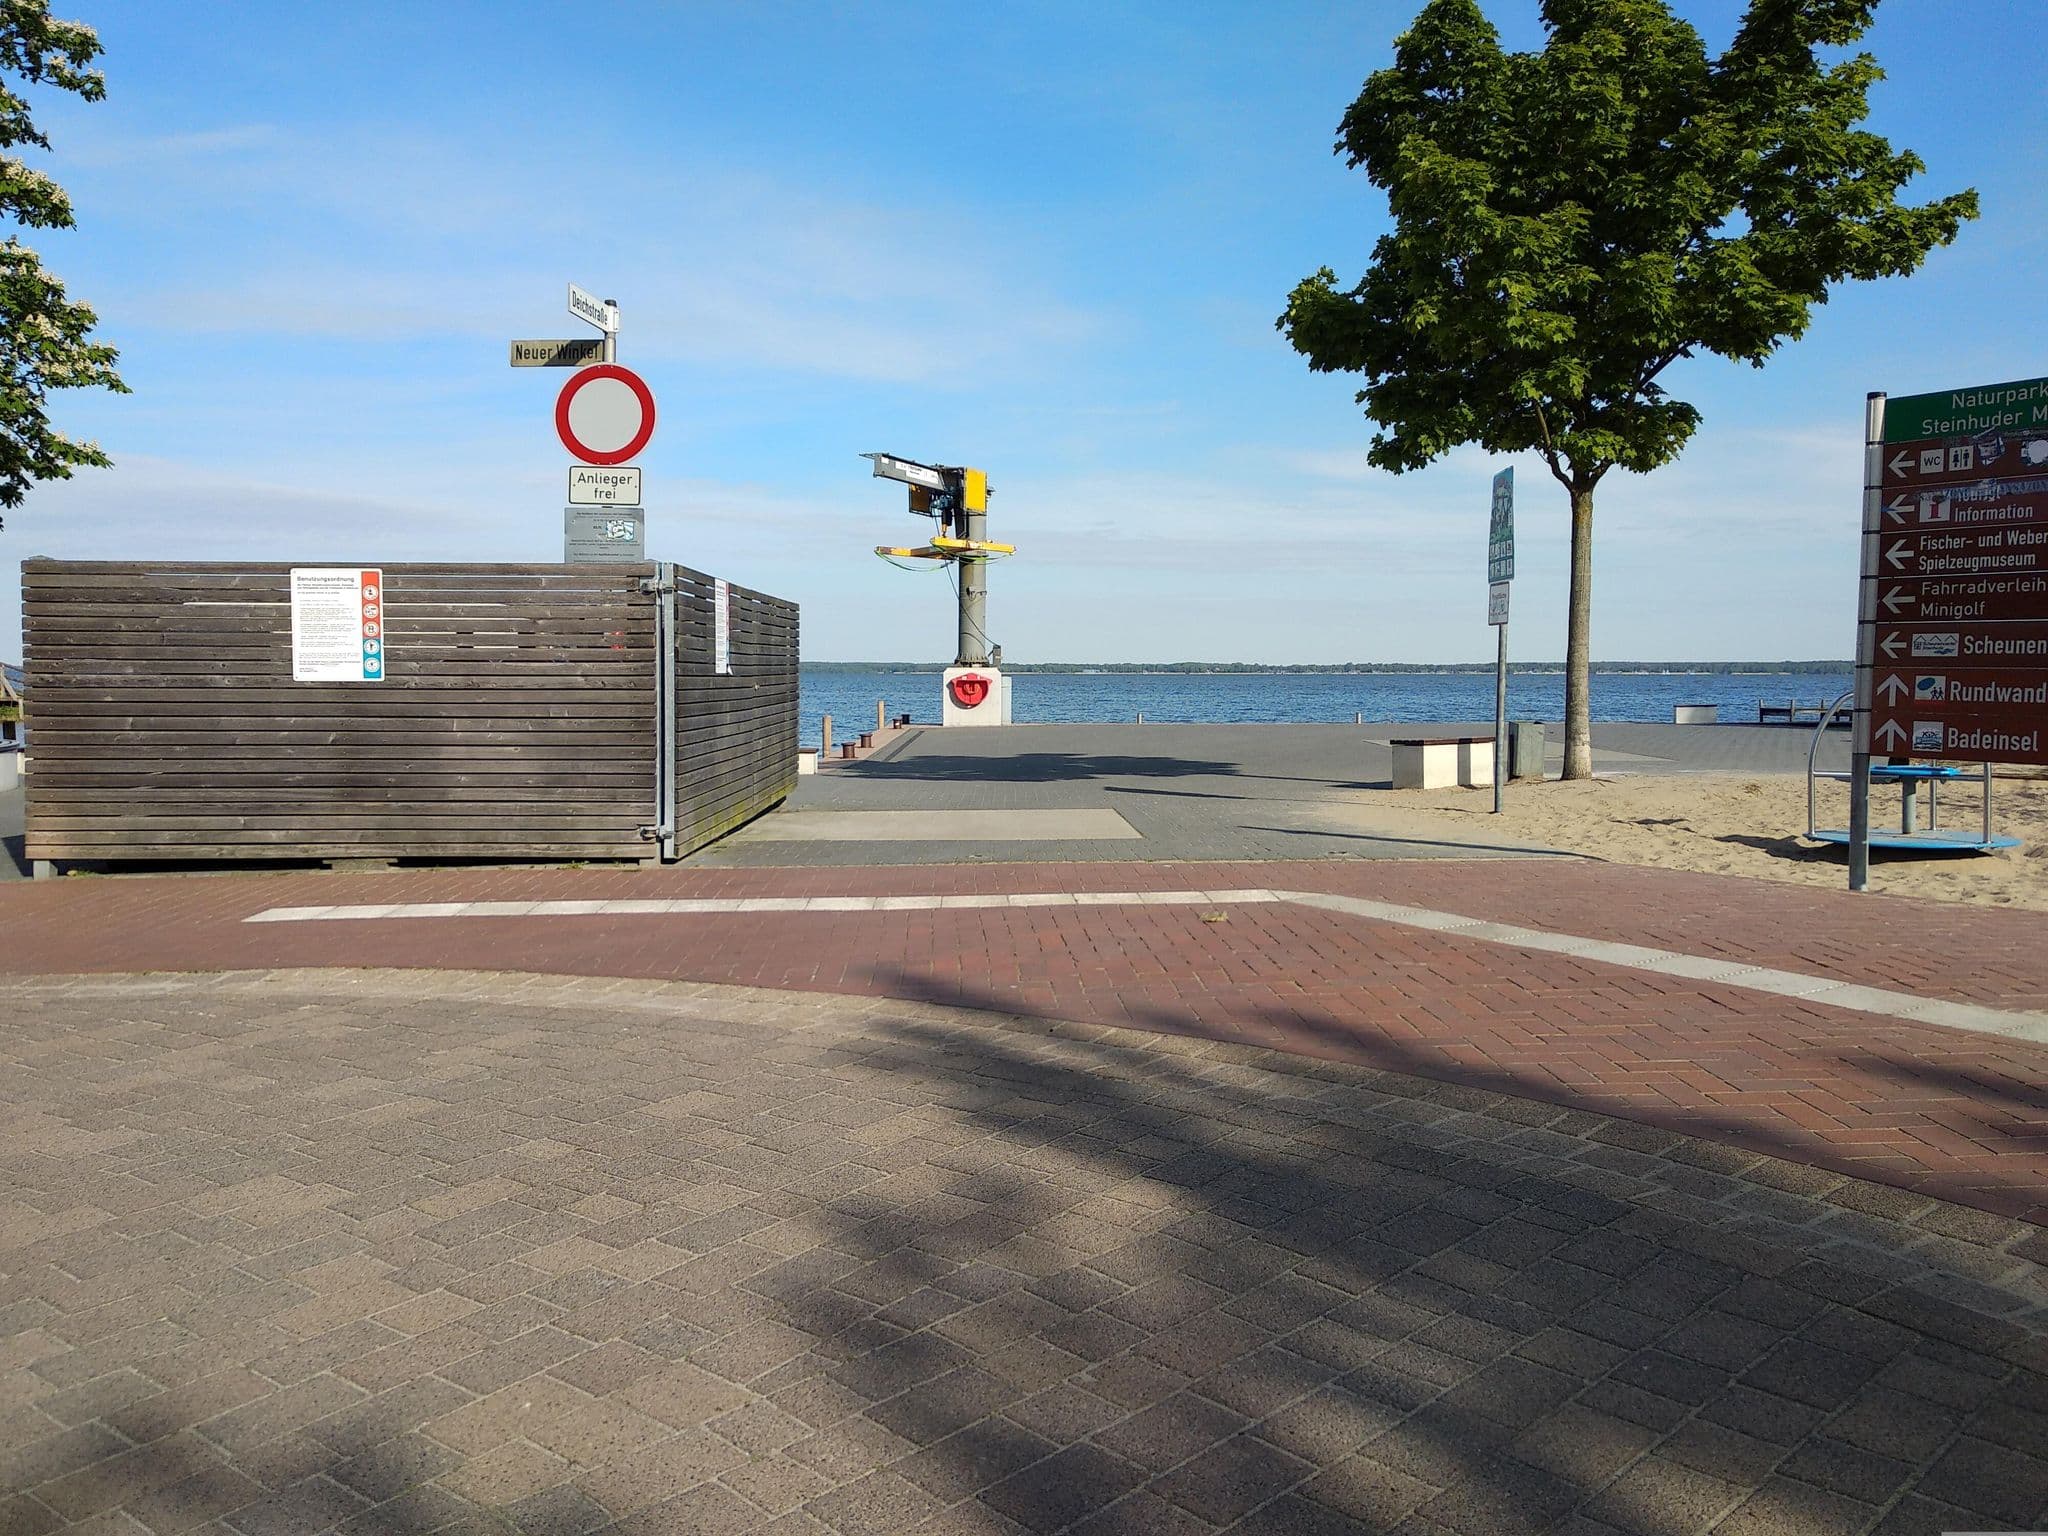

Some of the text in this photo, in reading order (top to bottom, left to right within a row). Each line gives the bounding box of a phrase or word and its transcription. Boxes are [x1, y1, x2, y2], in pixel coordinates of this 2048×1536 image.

[572, 290, 608, 325] Deichstraße
[515, 343, 598, 360] Neuer Winkel
[1952, 381, 2048, 409] Naturpark
[1922, 411, 2023, 435] Steinhuder
[1923, 455, 1941, 467] WC
[577, 472, 633, 487] Anlieger
[594, 487, 616, 499] frei
[1954, 504, 2034, 523] Information
[1920, 535, 1974, 551] Fischer-
[1978, 531, 2001, 547] und
[1919, 553, 2036, 574] Spielzeugmuseum
[1921, 577, 2046, 596] Fahrradverleih
[1920, 601, 1986, 620] Minigolf
[1948, 727, 2039, 752] Badeinsel
